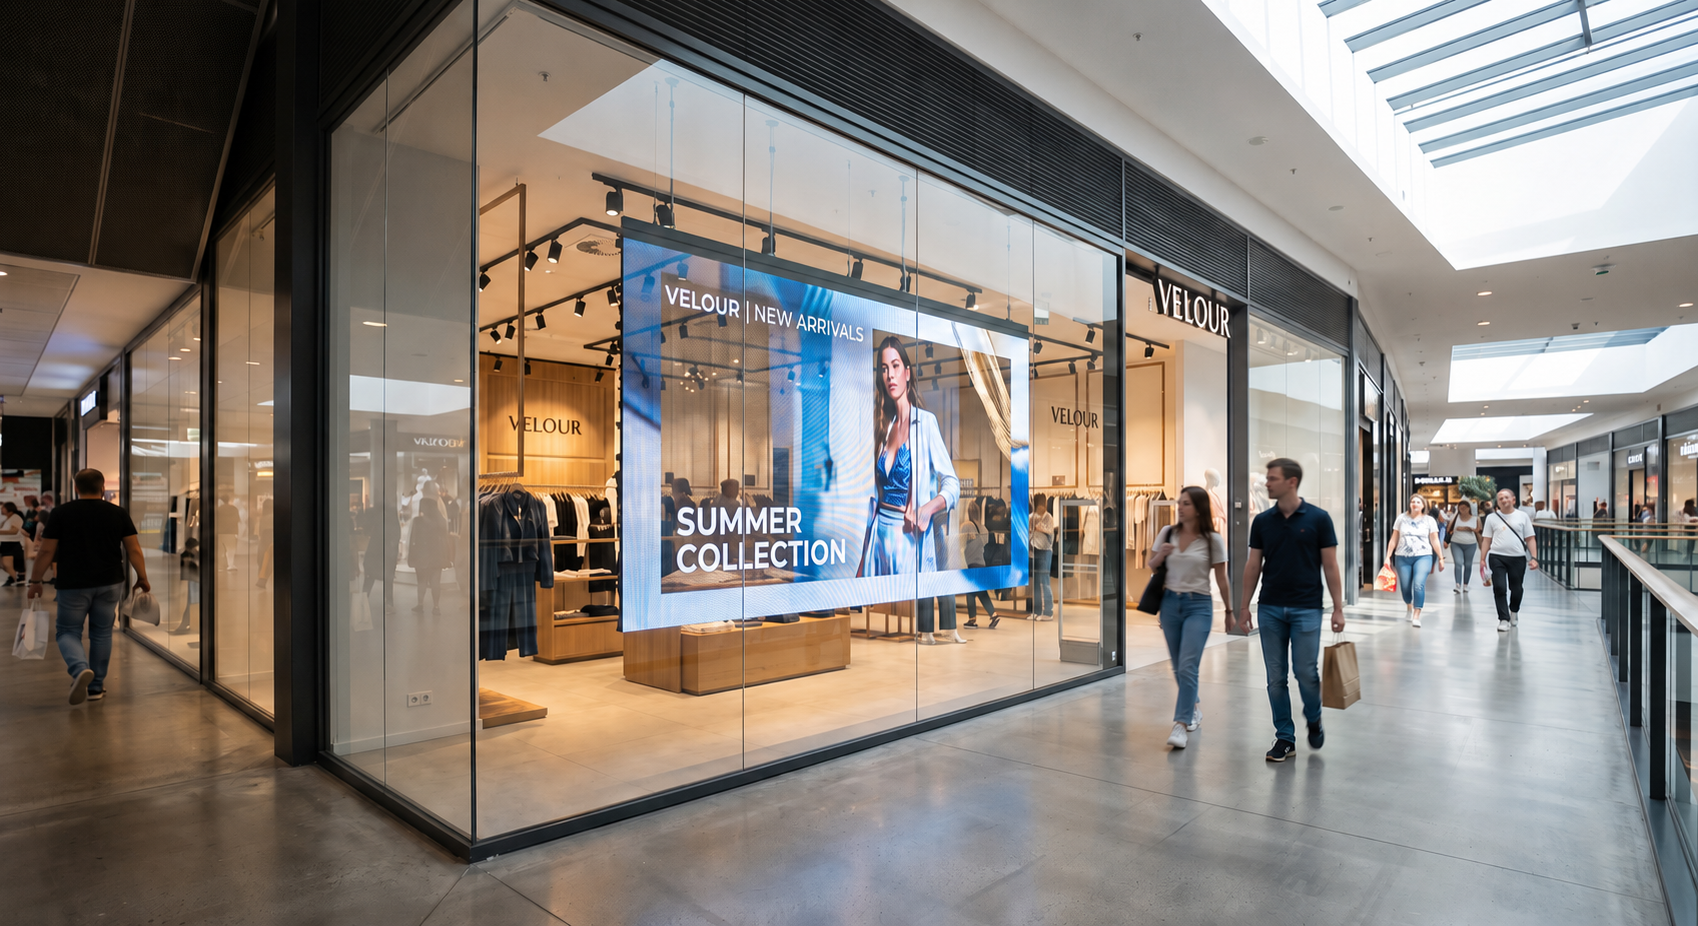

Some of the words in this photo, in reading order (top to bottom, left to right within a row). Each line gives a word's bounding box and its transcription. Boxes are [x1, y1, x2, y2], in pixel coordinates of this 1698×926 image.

[664, 284, 740, 319] VELOUR
[754, 303, 793, 328] NEW
[796, 313, 864, 342] ARRIVALS
[1158, 278, 1231, 339] VELOUR
[508, 415, 582, 436] VELOUR
[1051, 405, 1099, 429] VELOUR
[676, 506, 802, 537] SUMMER
[676, 538, 846, 574] COLLECTION
